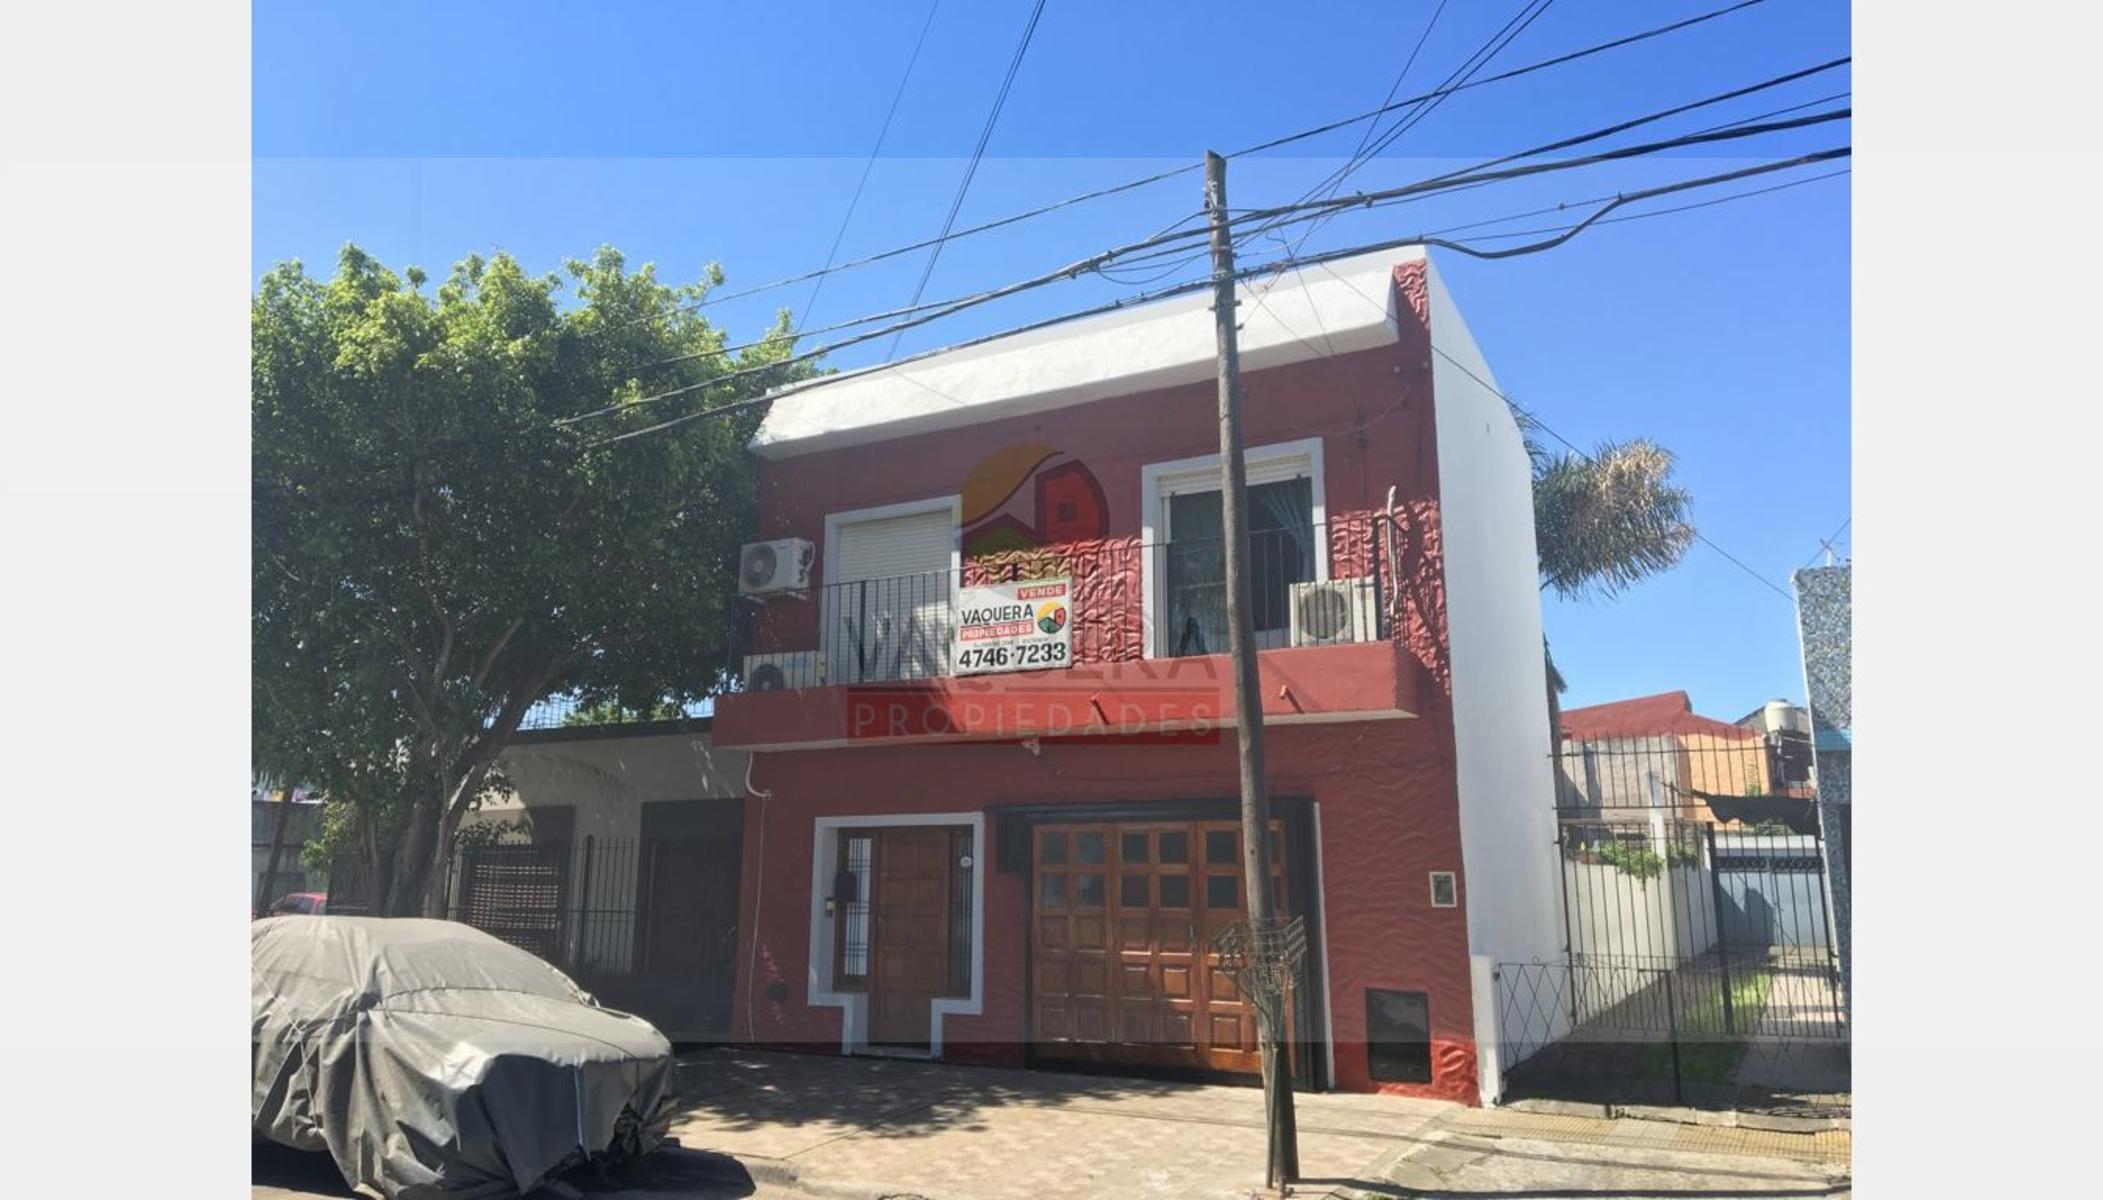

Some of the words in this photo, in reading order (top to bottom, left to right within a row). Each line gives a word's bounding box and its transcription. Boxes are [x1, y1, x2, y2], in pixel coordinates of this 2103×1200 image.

[1020, 584, 1063, 598] VENDE
[961, 604, 1034, 625] VAQUERA
[961, 623, 1033, 640] PROPIEDADES
